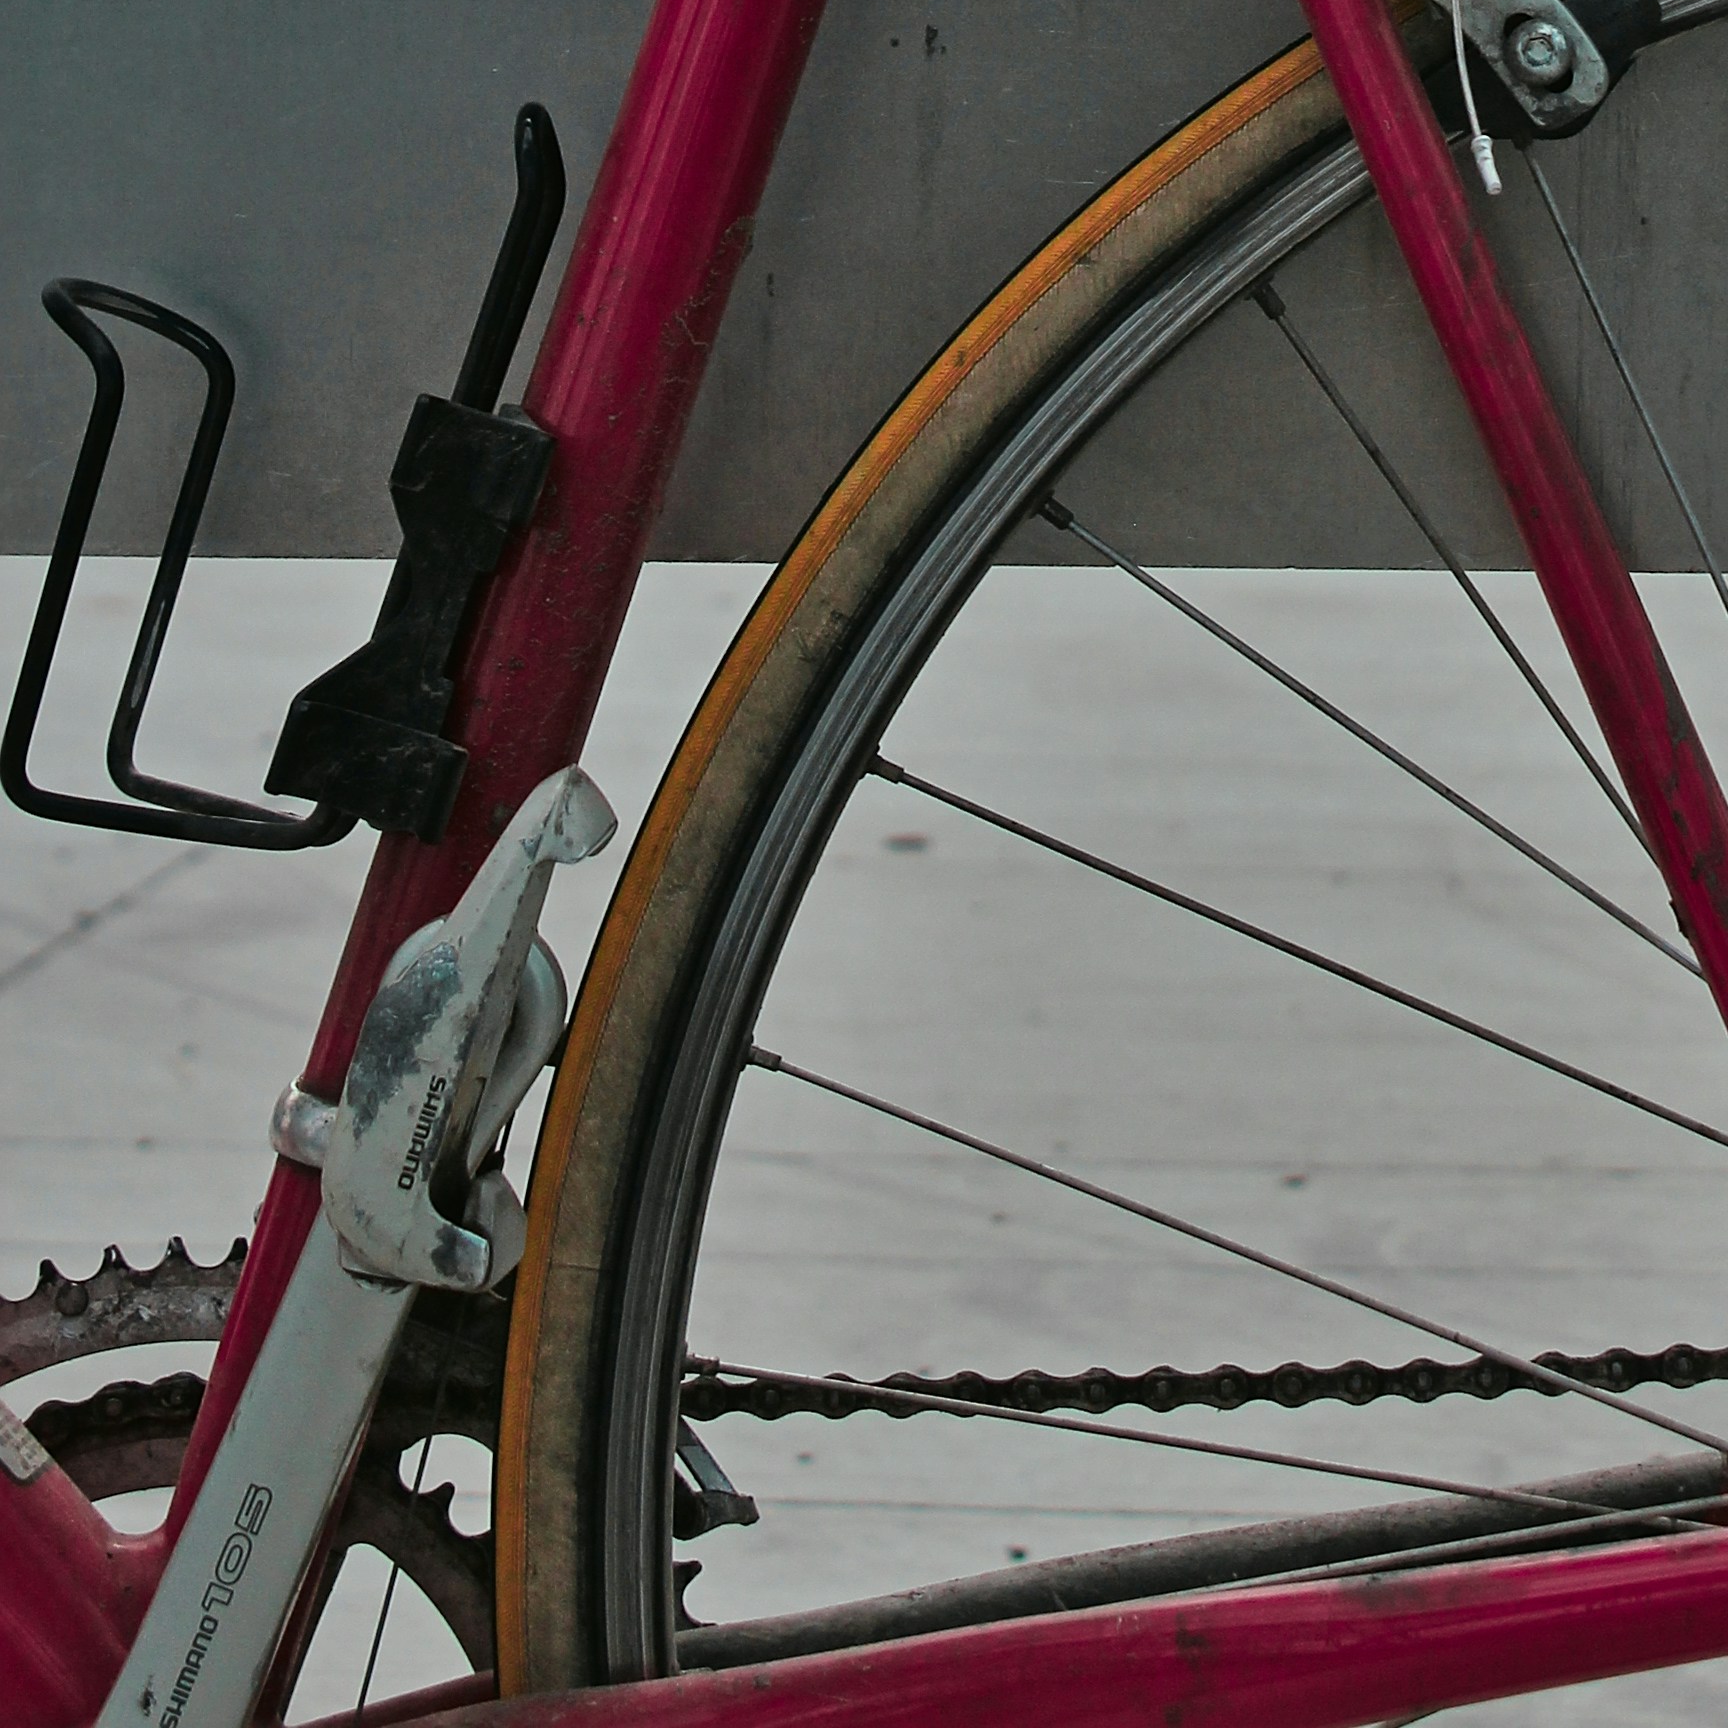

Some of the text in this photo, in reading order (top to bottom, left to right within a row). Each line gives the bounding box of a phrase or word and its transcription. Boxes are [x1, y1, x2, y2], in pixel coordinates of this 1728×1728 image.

[398, 1075, 447, 1190] SHIMANO
[159, 1483, 273, 1728] SHIMANO 105
